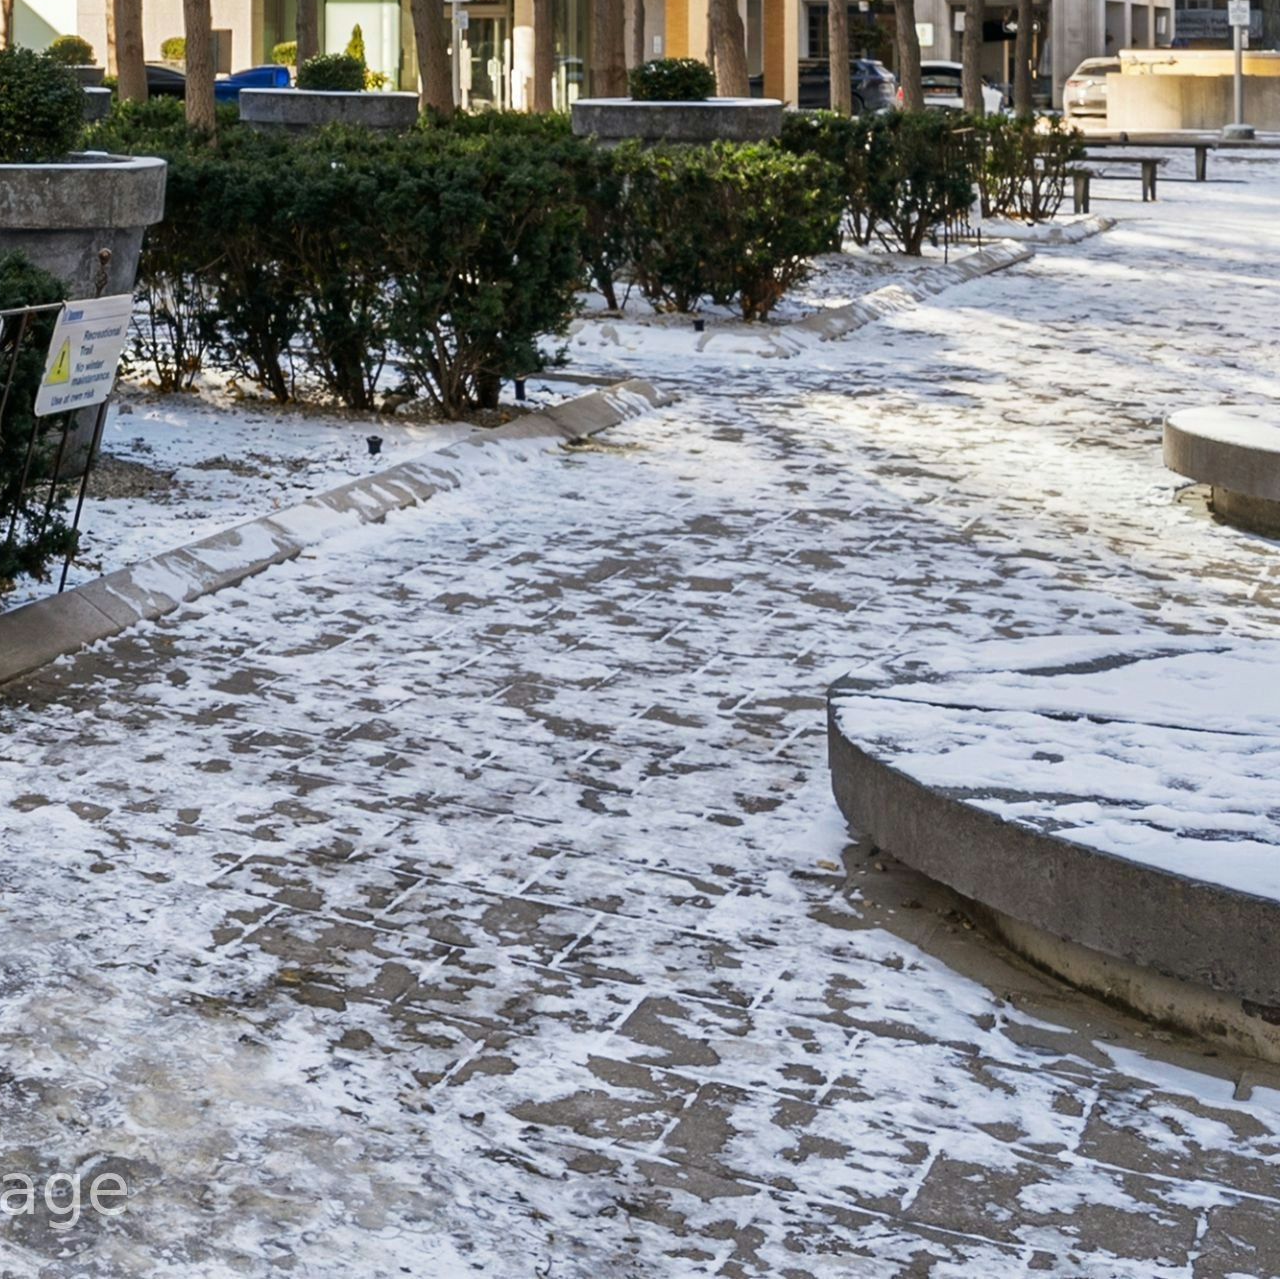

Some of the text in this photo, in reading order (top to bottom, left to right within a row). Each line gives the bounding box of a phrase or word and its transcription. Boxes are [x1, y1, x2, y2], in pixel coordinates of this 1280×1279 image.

[83, 325, 122, 341] Recreational
[80, 344, 95, 356] Trail
[74, 360, 105, 373] No winter
[50, 396, 64, 407] Use
[71, 392, 83, 402] own
